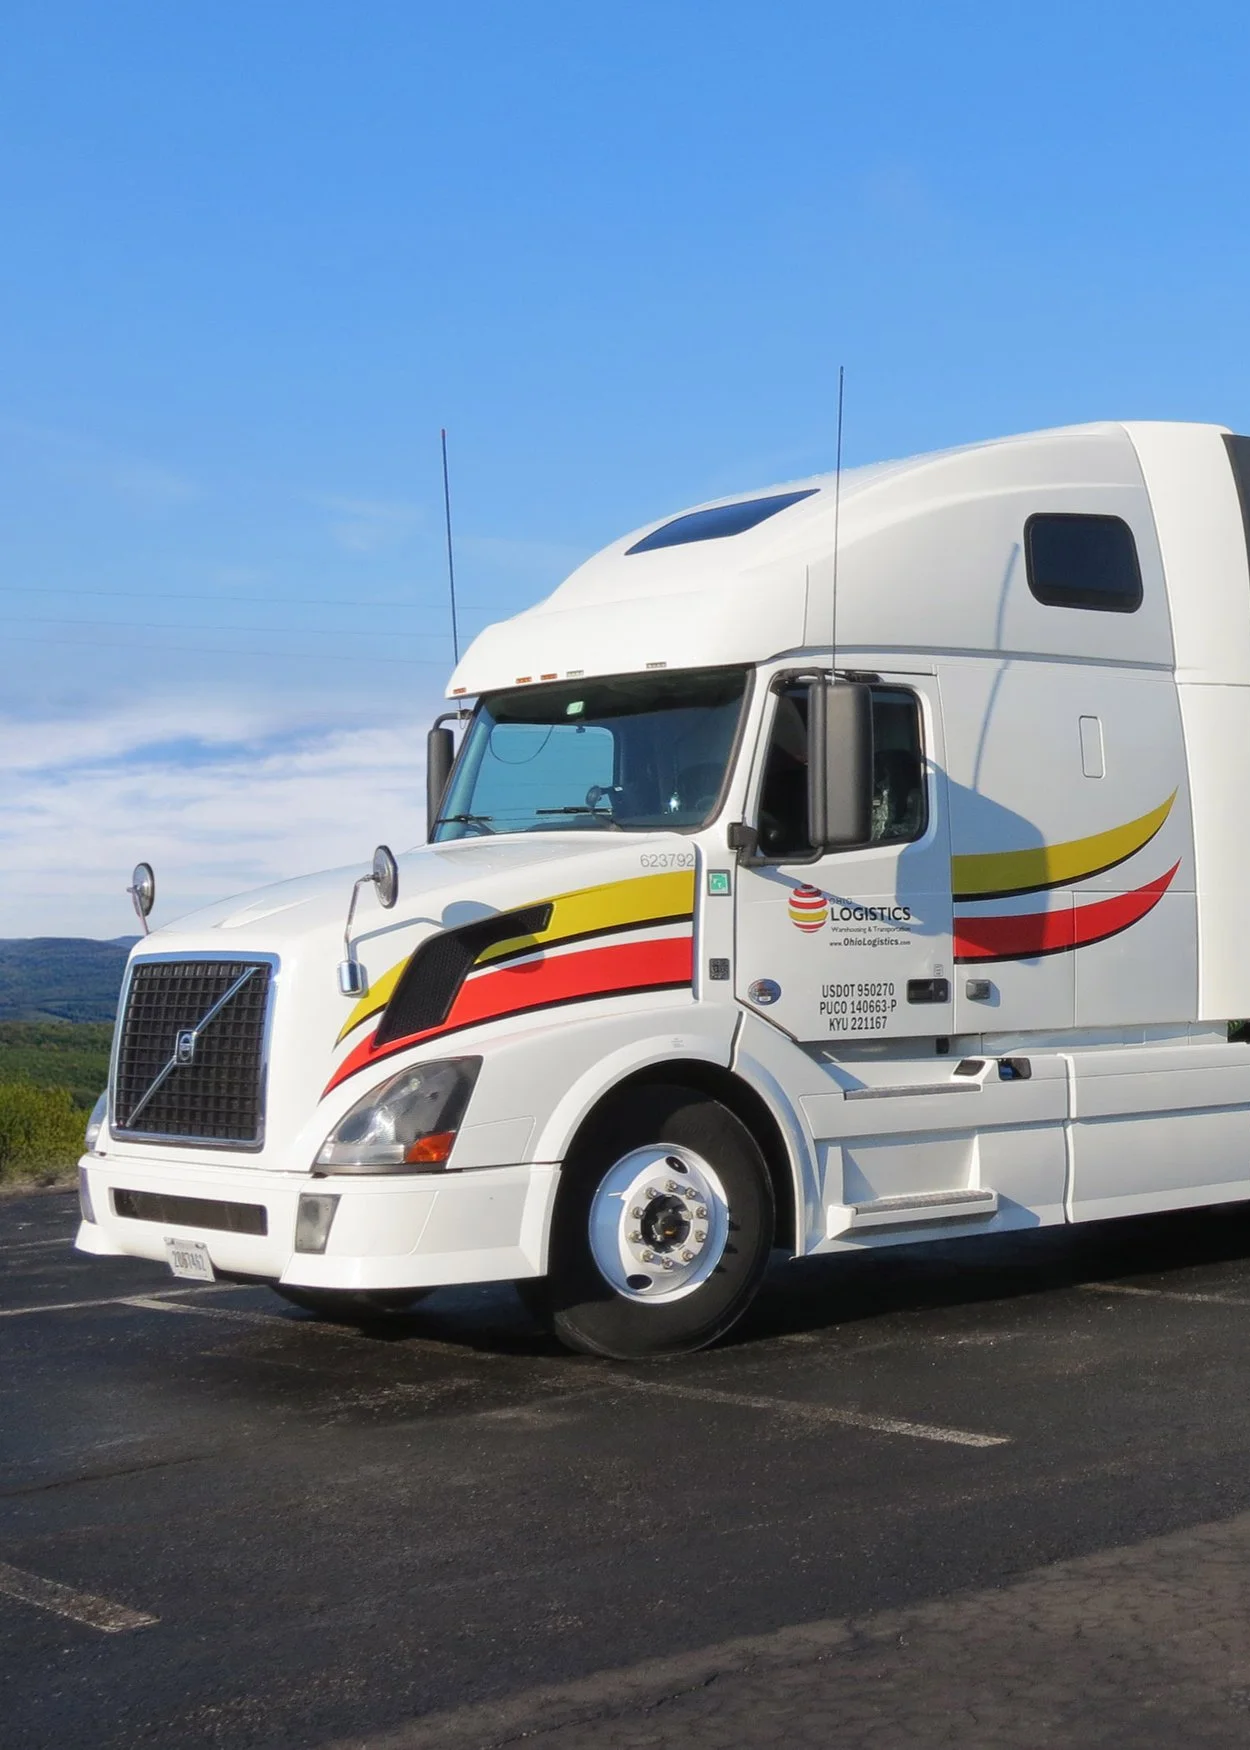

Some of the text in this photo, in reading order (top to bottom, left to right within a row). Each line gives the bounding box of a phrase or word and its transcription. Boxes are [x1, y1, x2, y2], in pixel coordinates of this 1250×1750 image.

[640, 853, 695, 868] 623792
[831, 906, 911, 921] LOGISTICS
[822, 982, 895, 998] USDOT 950270
[820, 999, 897, 1015] PUCO 140663-P
[829, 1016, 888, 1031] KYU 221167
